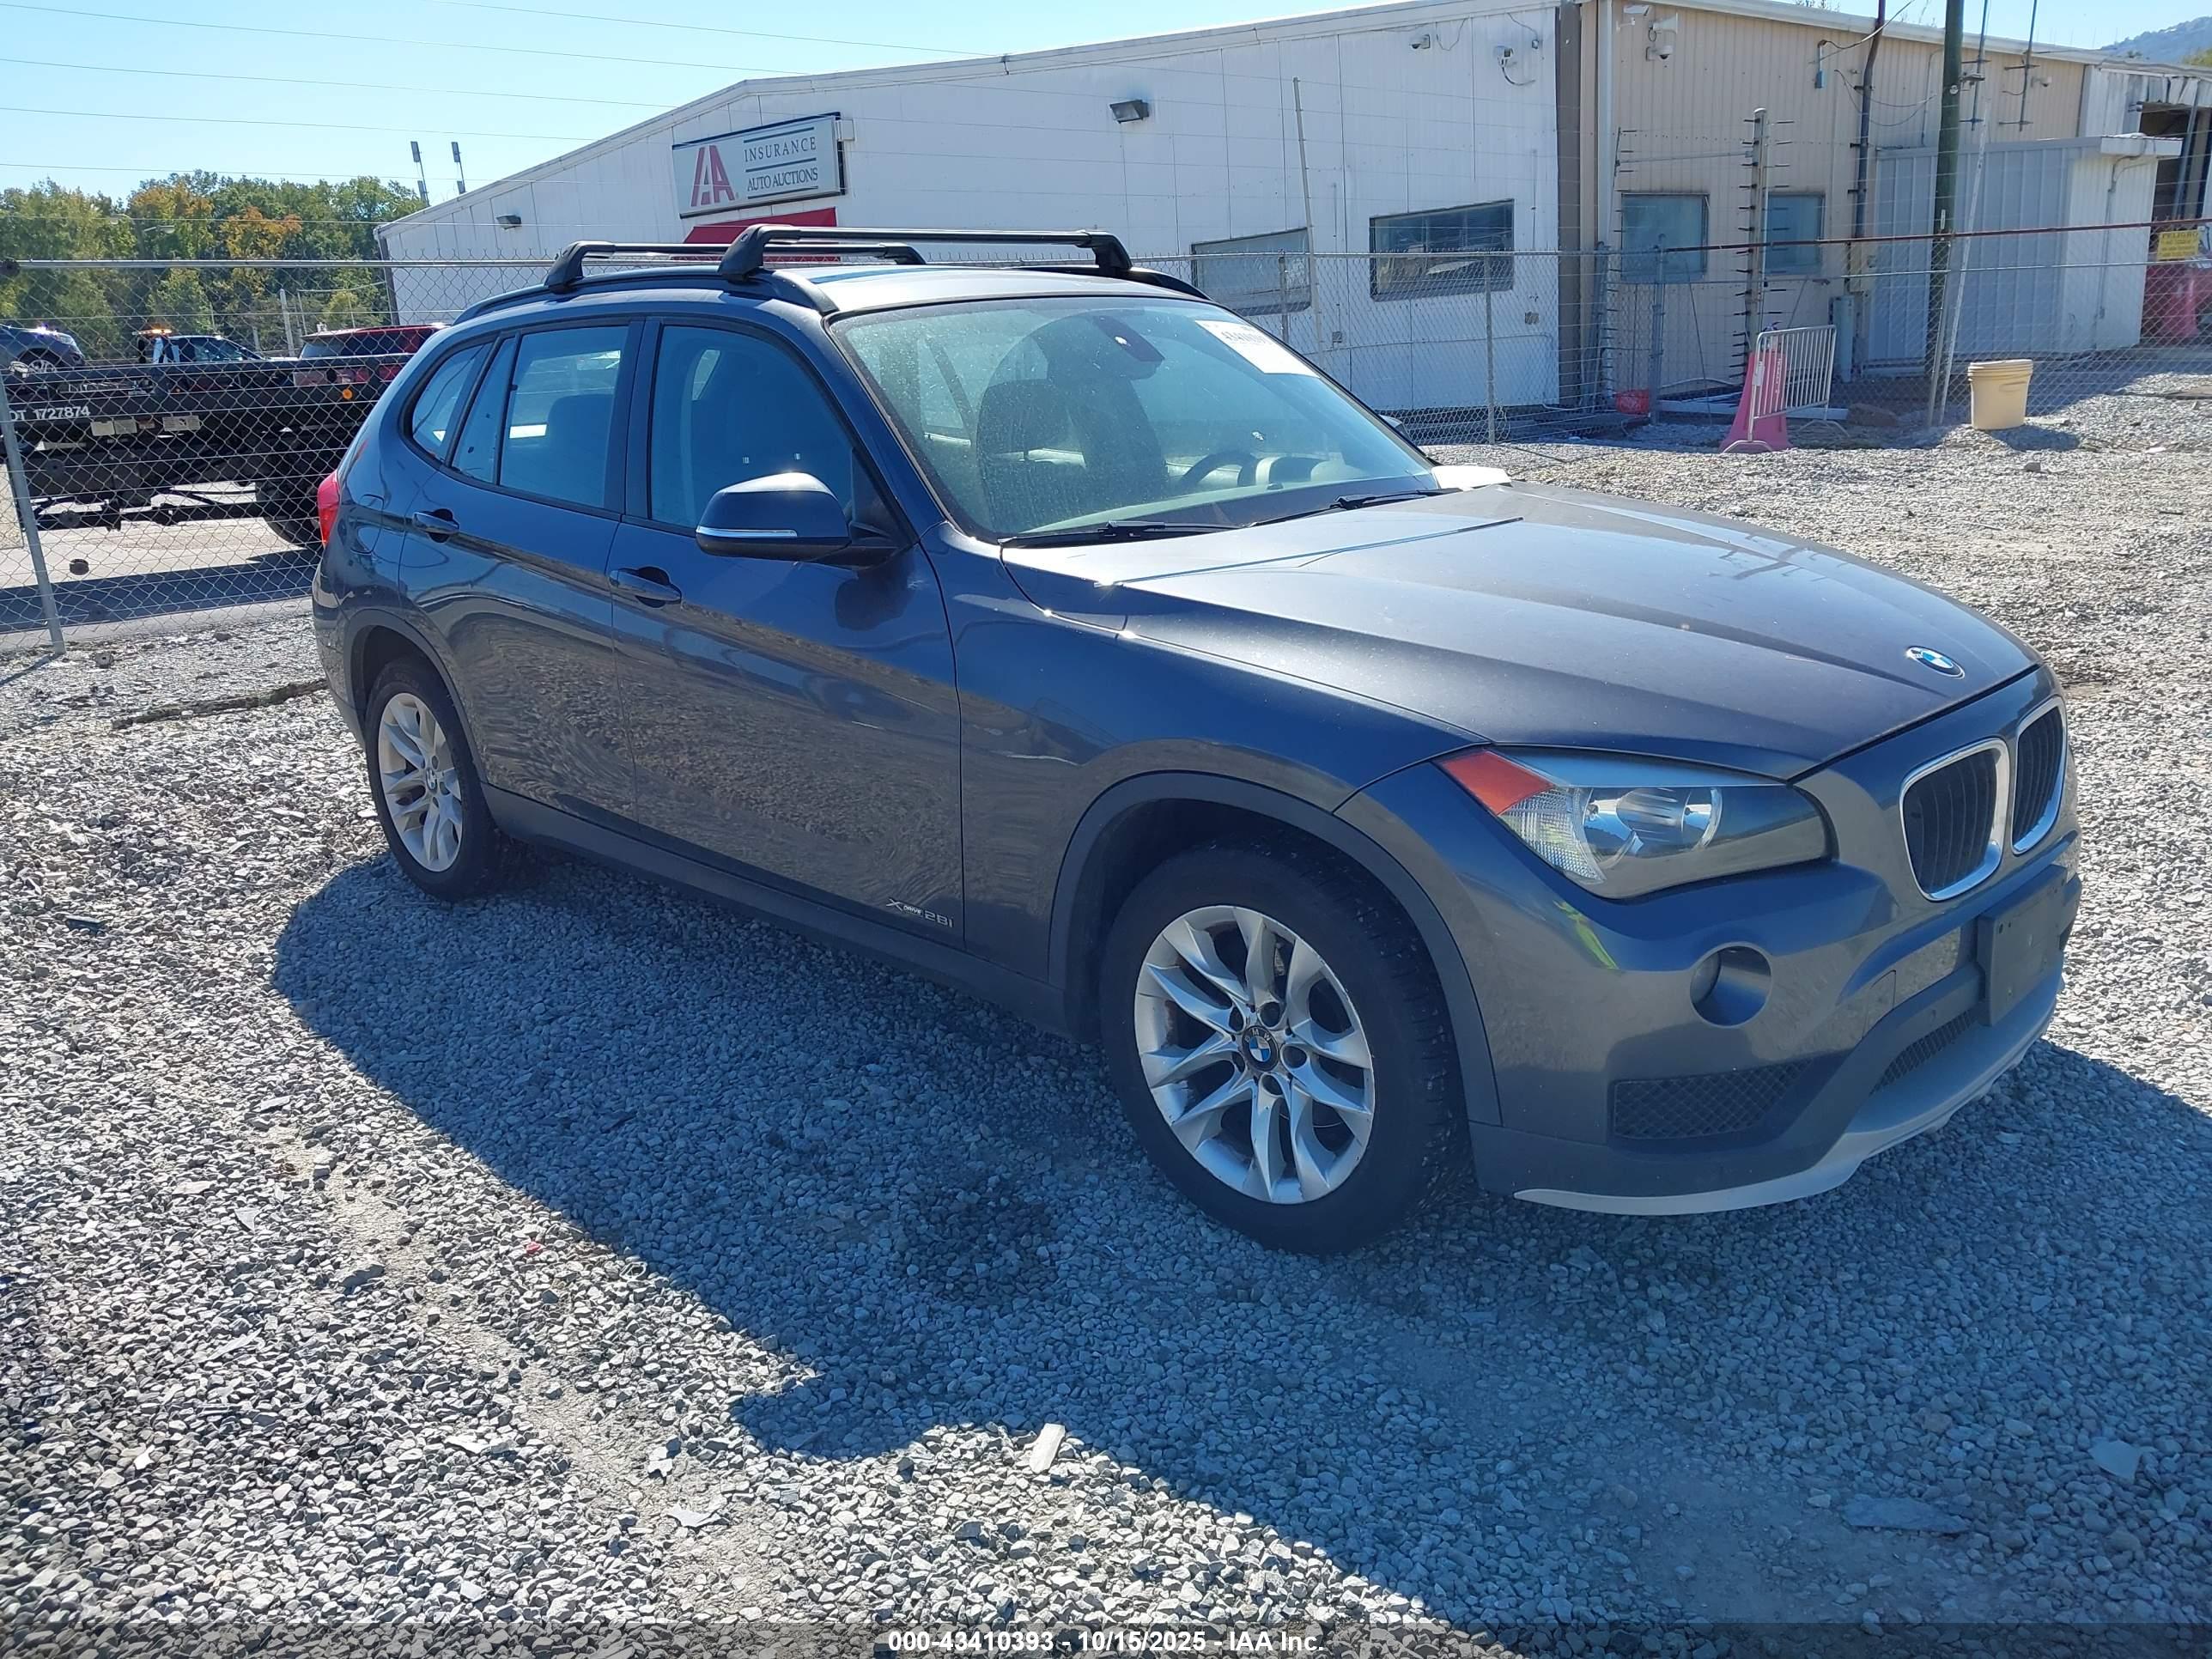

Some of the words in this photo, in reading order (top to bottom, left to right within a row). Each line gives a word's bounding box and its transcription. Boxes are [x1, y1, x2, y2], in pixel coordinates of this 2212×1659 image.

[744, 137, 817, 162] INSURANCE
[747, 174, 772, 191] AUTO
[772, 167, 818, 188] AUCTIONS
[33, 406, 90, 420] 1727874
[1244, 1027, 1272, 1042] BMW
